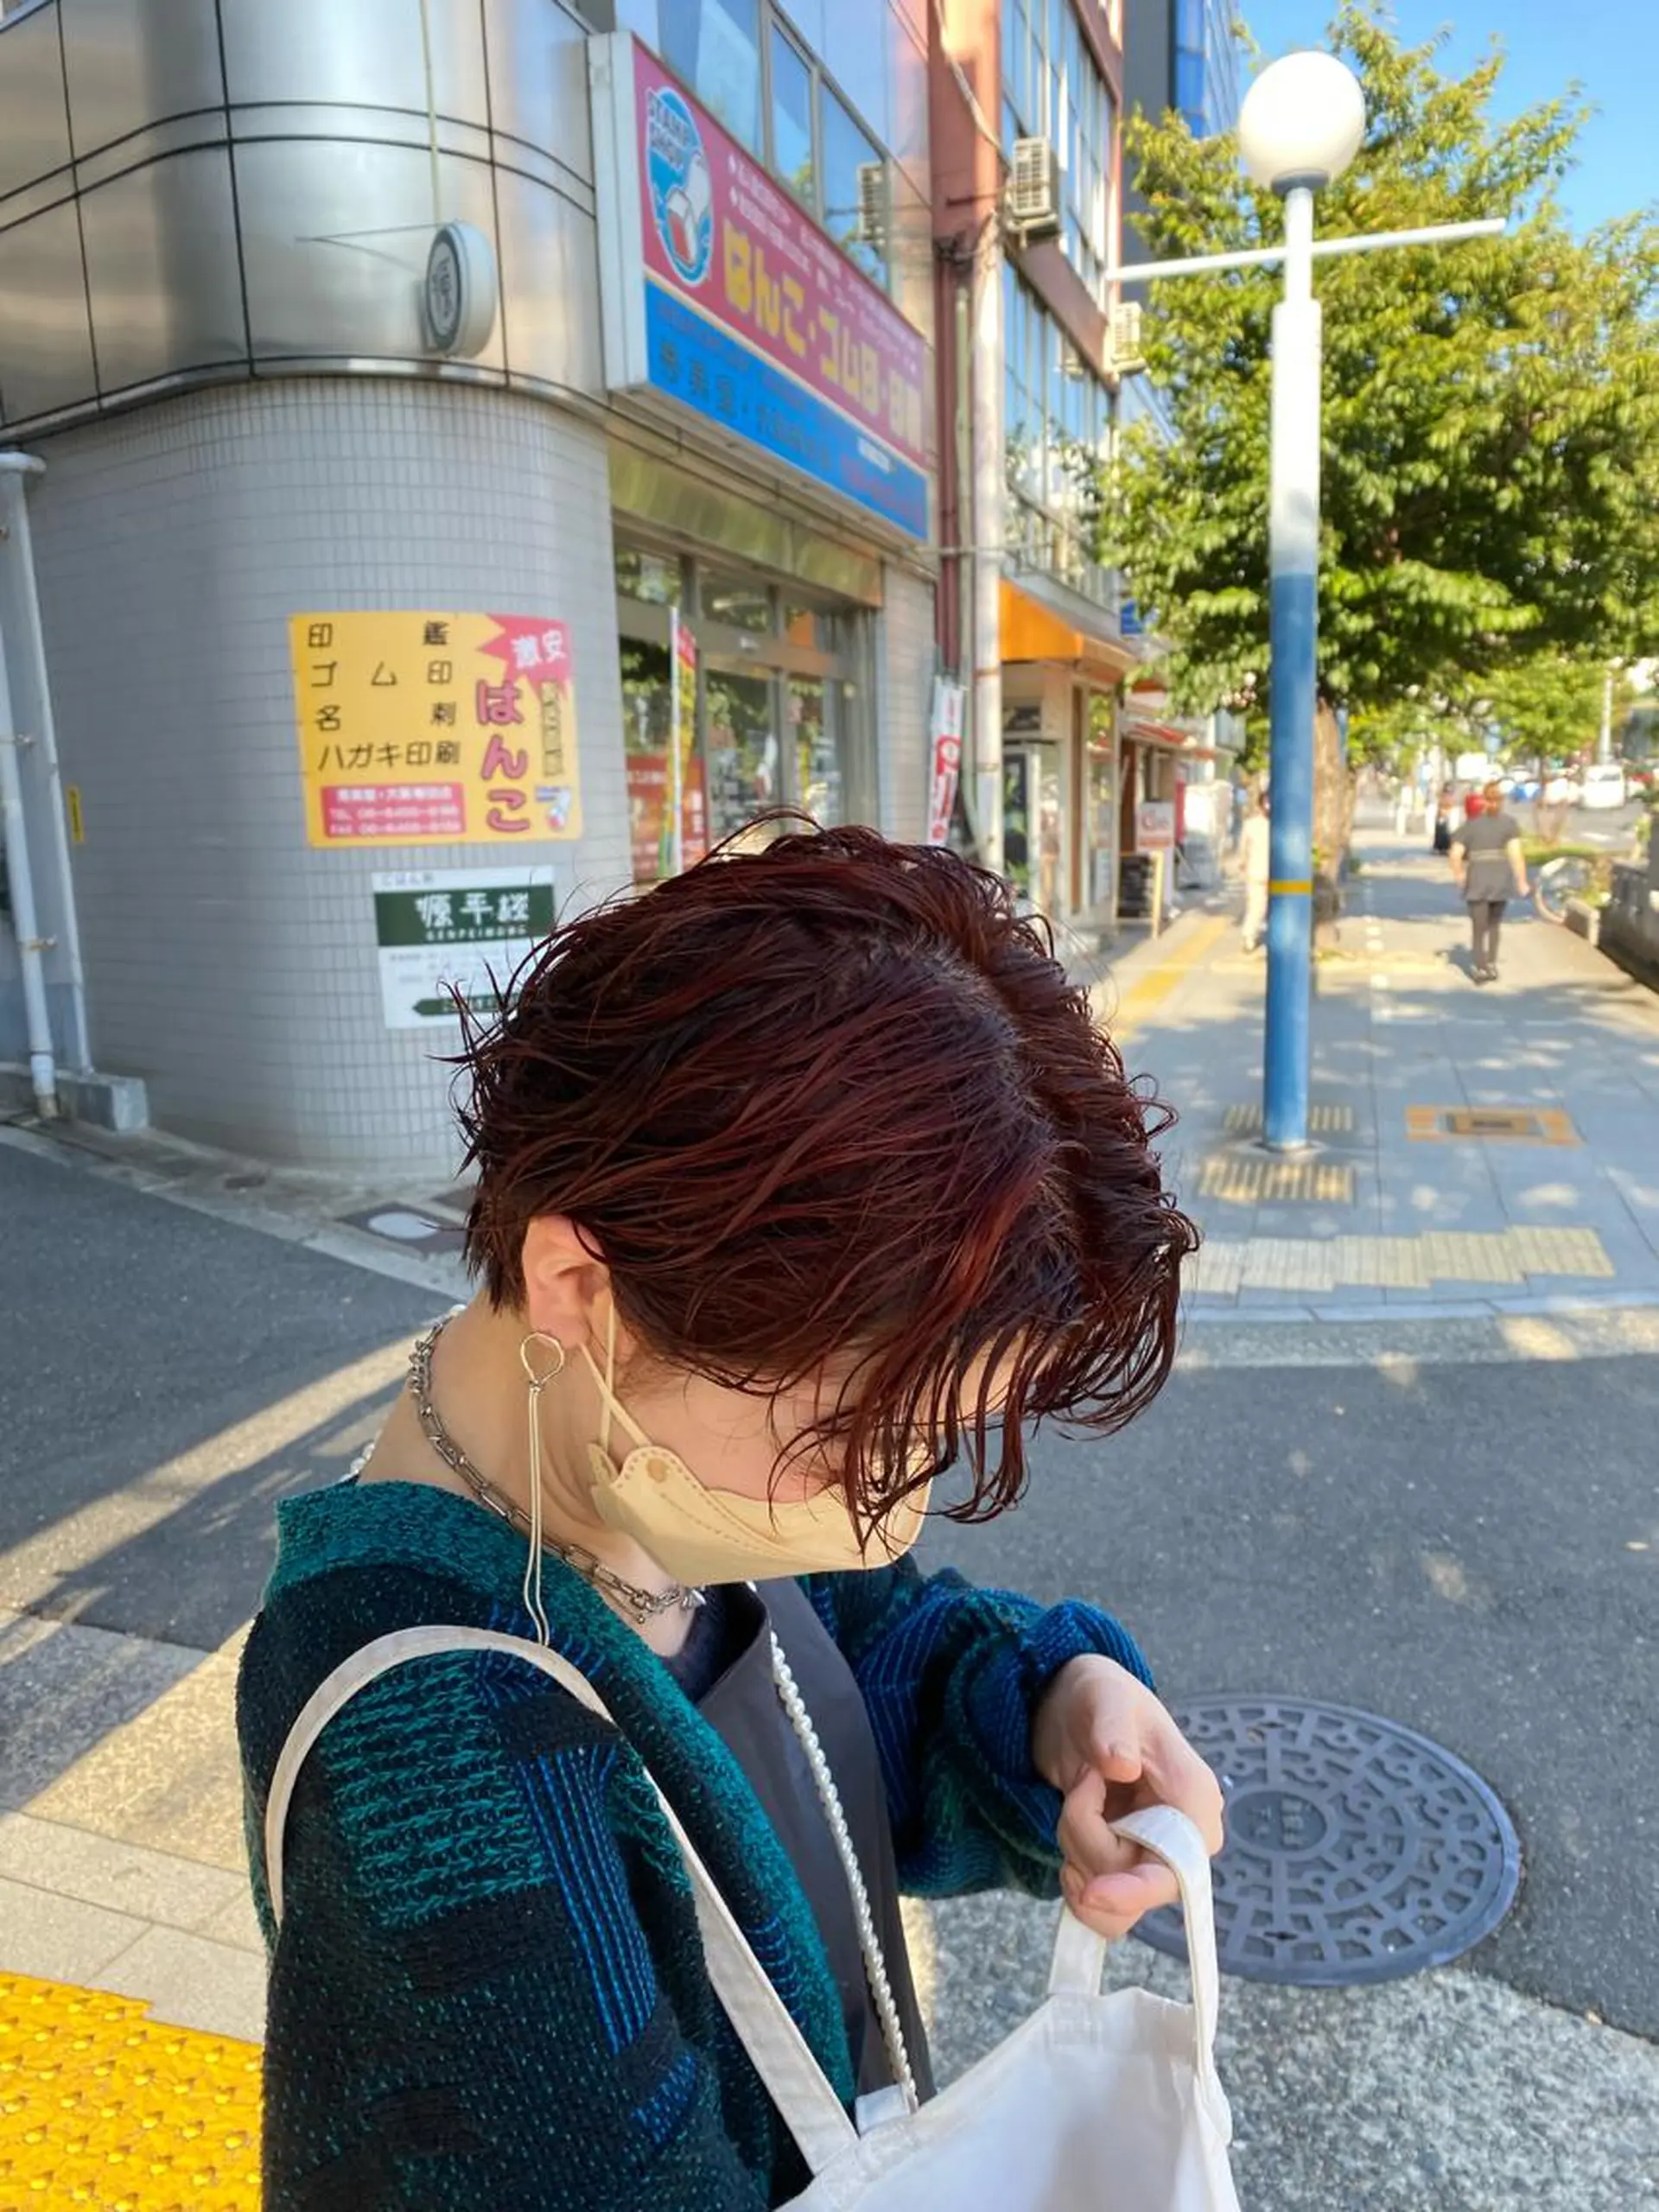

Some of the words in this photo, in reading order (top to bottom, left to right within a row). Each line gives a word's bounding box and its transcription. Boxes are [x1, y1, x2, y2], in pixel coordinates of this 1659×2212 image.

[310, 659, 453, 688] ゴム印
[317, 741, 461, 772] ハガキ印刷
[475, 678, 531, 833] はんこ
